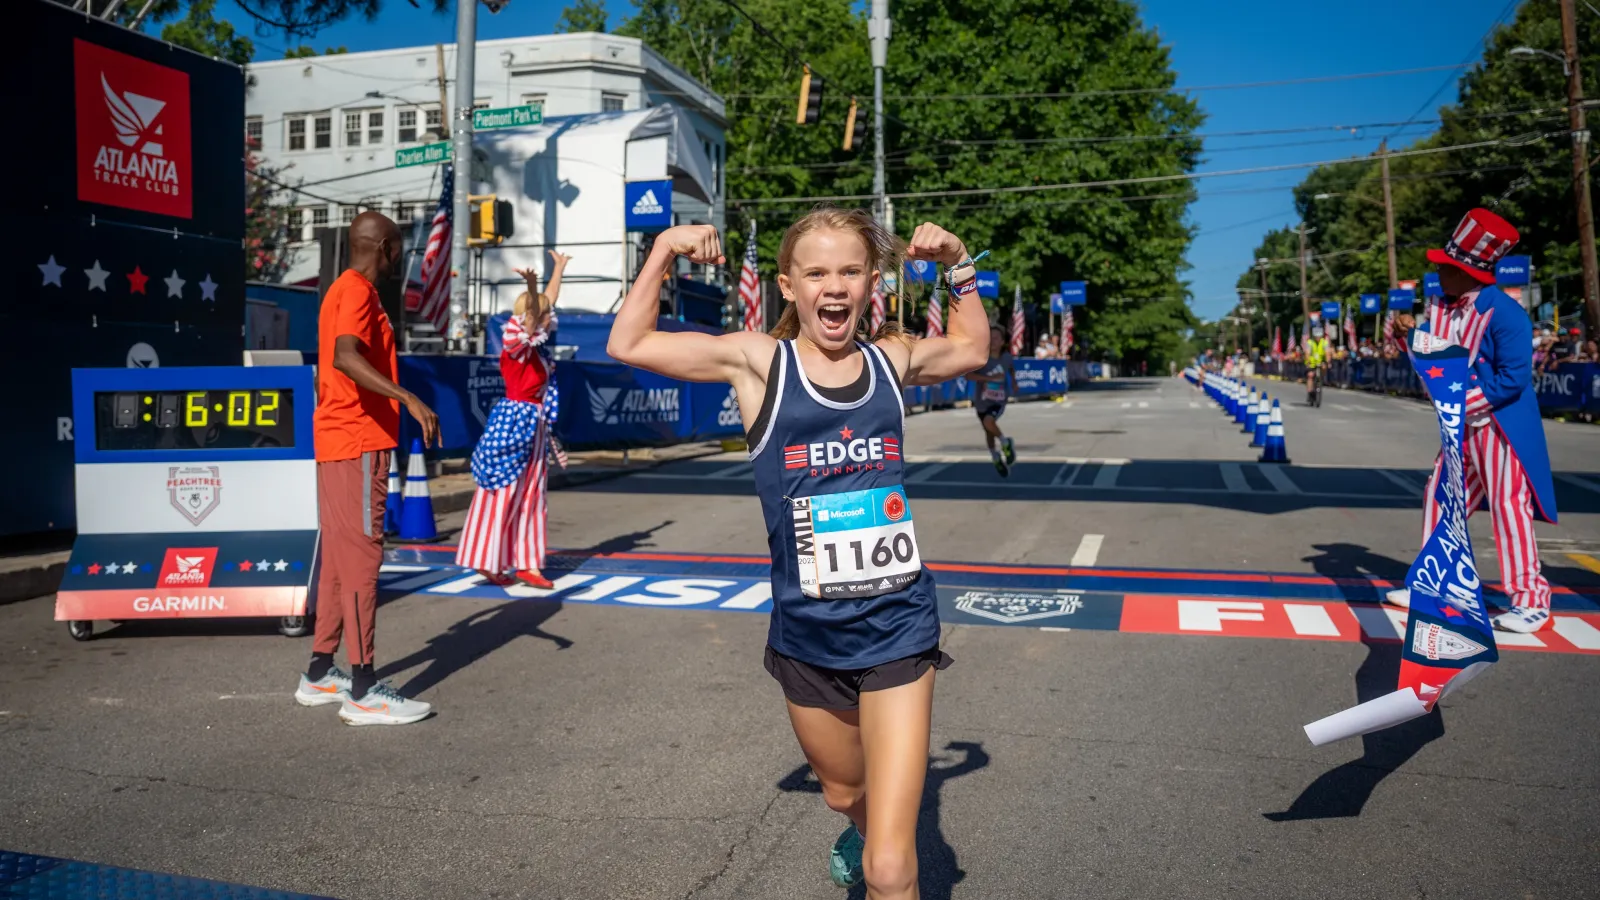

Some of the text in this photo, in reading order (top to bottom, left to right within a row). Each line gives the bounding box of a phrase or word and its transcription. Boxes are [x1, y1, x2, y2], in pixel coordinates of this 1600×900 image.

[475, 112, 512, 126] Piedmont
[513, 108, 530, 123] Park
[94, 145, 179, 185] ATLANTA
[397, 151, 424, 165] Charles
[425, 147, 443, 160] Allen
[94, 169, 179, 196] TRACK CLUB
[632, 204, 664, 215] adidas
[467, 376, 505, 389] PEACHT
[1541, 373, 1576, 396] PNC
[621, 388, 680, 412] ATLANTA
[620, 411, 680, 423] TRACK CLUB
[809, 438, 884, 467] EDGE
[810, 462, 885, 477] RUNNING
[167, 478, 222, 487] PEACHTREE
[830, 508, 865, 519] Microsoft
[794, 499, 815, 556] MILE
[824, 532, 914, 573] 1160
[896, 575, 916, 584] DASANI
[133, 595, 225, 612] GARMIN
[1427, 625, 1440, 659] PEACHTREE
